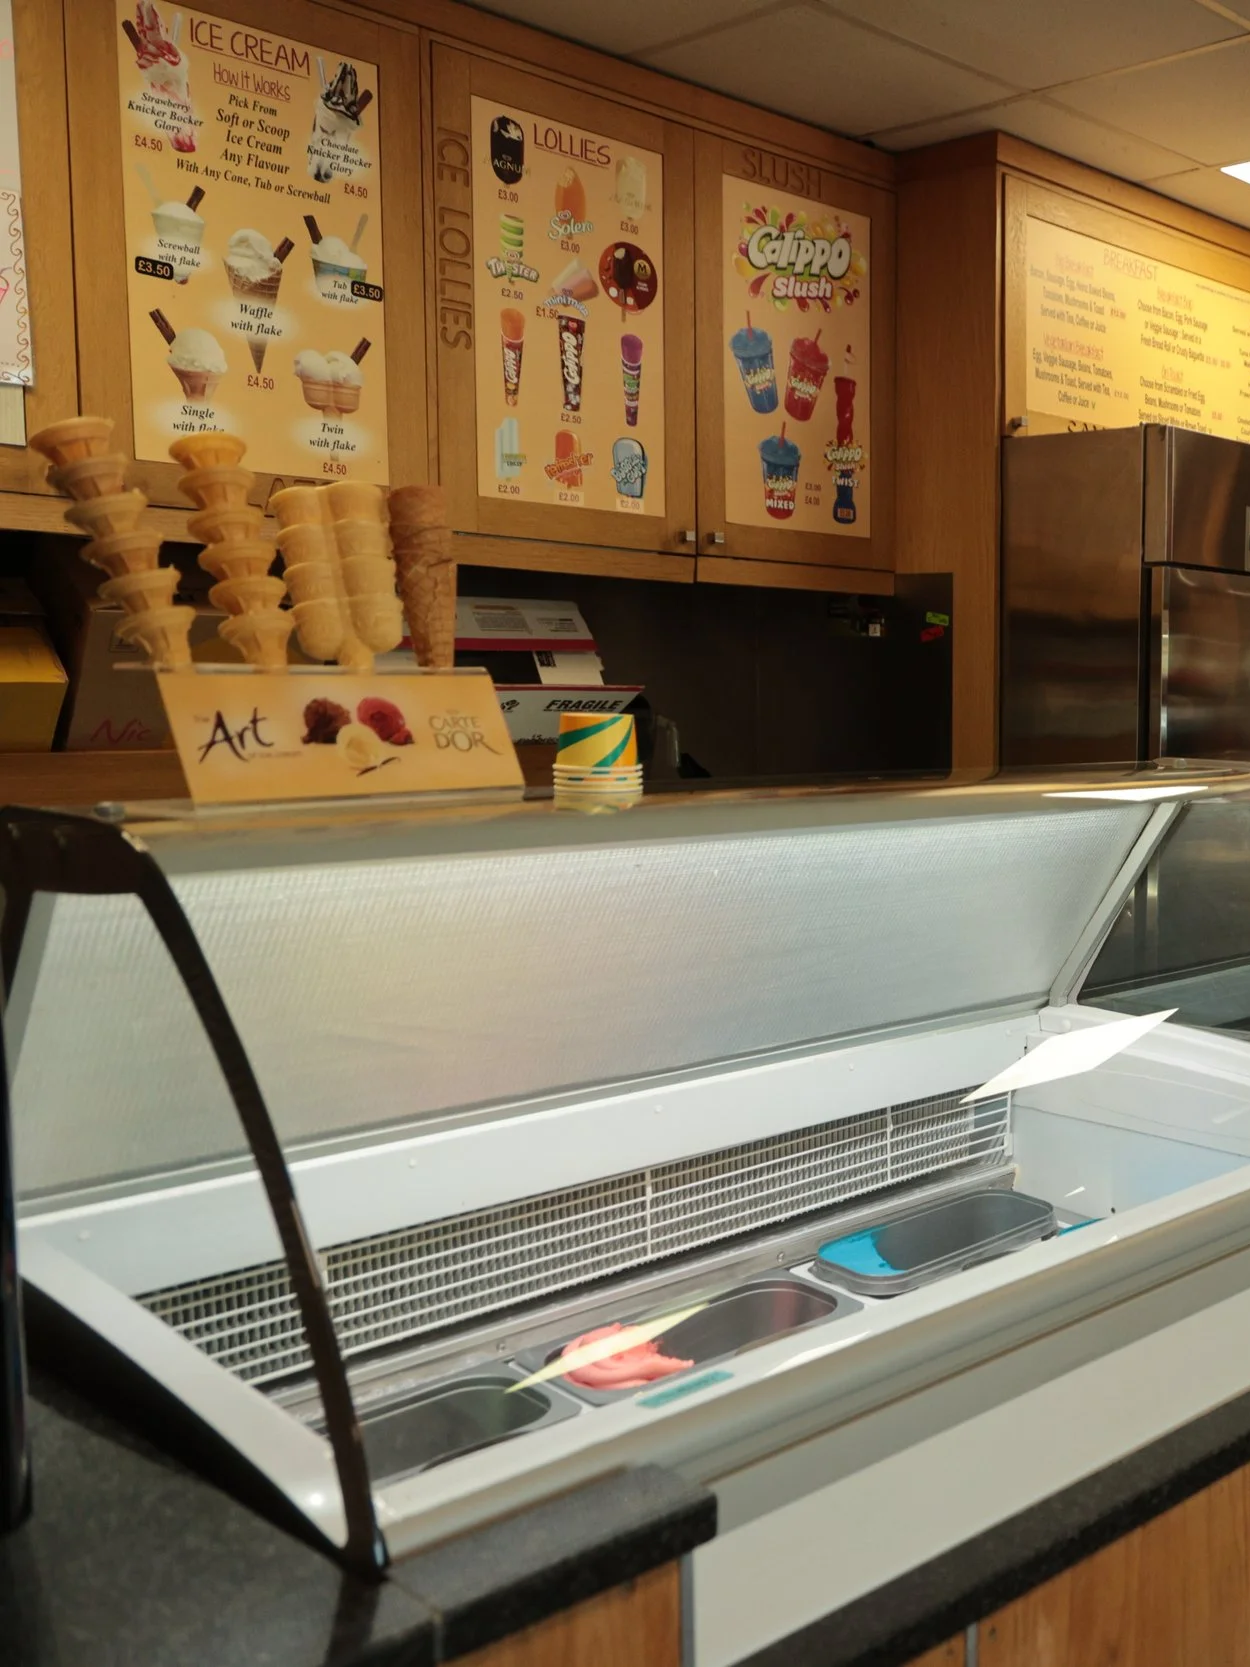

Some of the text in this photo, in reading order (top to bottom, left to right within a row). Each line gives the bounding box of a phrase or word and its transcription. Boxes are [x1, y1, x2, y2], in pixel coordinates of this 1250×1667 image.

[190, 17, 310, 76] ICE CREAM
[141, 92, 191, 113] Strawberry
[229, 94, 277, 117] Pick From
[127, 100, 204, 128] Knicker Bocker
[154, 119, 182, 135] Glory
[216, 109, 290, 142] Soft or Scoop
[134, 134, 163, 152] £4.50
[226, 130, 283, 155] Ice Cream
[321, 137, 359, 155] Chocolate
[533, 122, 611, 166] LOLLIES
[220, 148, 290, 176] Any Flavour
[306, 145, 373, 170] Knicker Bocker
[329, 162, 354, 177] Glory
[742, 151, 822, 199] SLUSH
[176, 158, 331, 205] With Any Cone, Tub or Screwball
[343, 182, 368, 199] £4.50
[498, 188, 519, 203] £3.00
[620, 221, 639, 236] £3.00
[157, 238, 201, 255] Screwball
[436, 126, 474, 351] ICE LOLLIES
[560, 240, 581, 254] £3.00
[158, 252, 201, 268] with flake
[747, 224, 853, 280] Calippo
[138, 258, 171, 278] £3.50
[1103, 248, 1158, 282] BREAKFAST
[332, 280, 348, 291] Tub
[353, 282, 381, 300] £3.50
[501, 287, 524, 301] £2.50
[321, 290, 359, 305] with flake
[239, 303, 273, 320] Waffle
[230, 319, 283, 337] with flake
[247, 374, 274, 391] £4.50
[181, 404, 215, 420] Single
[560, 413, 582, 425] £2.50
[172, 420, 195, 432] with
[320, 422, 344, 435] Twin
[309, 437, 356, 452] with flake
[322, 461, 347, 476] £4.50
[498, 484, 520, 496] £2.00
[832, 476, 860, 489] TWIST
[558, 492, 580, 503] £2.00
[620, 499, 641, 510] £2.00
[765, 498, 796, 511] MIXED
[545, 698, 625, 712] FRAGILE
[89, 717, 152, 745] Nic
[428, 714, 484, 731] CARTE
[197, 706, 276, 765] Art
